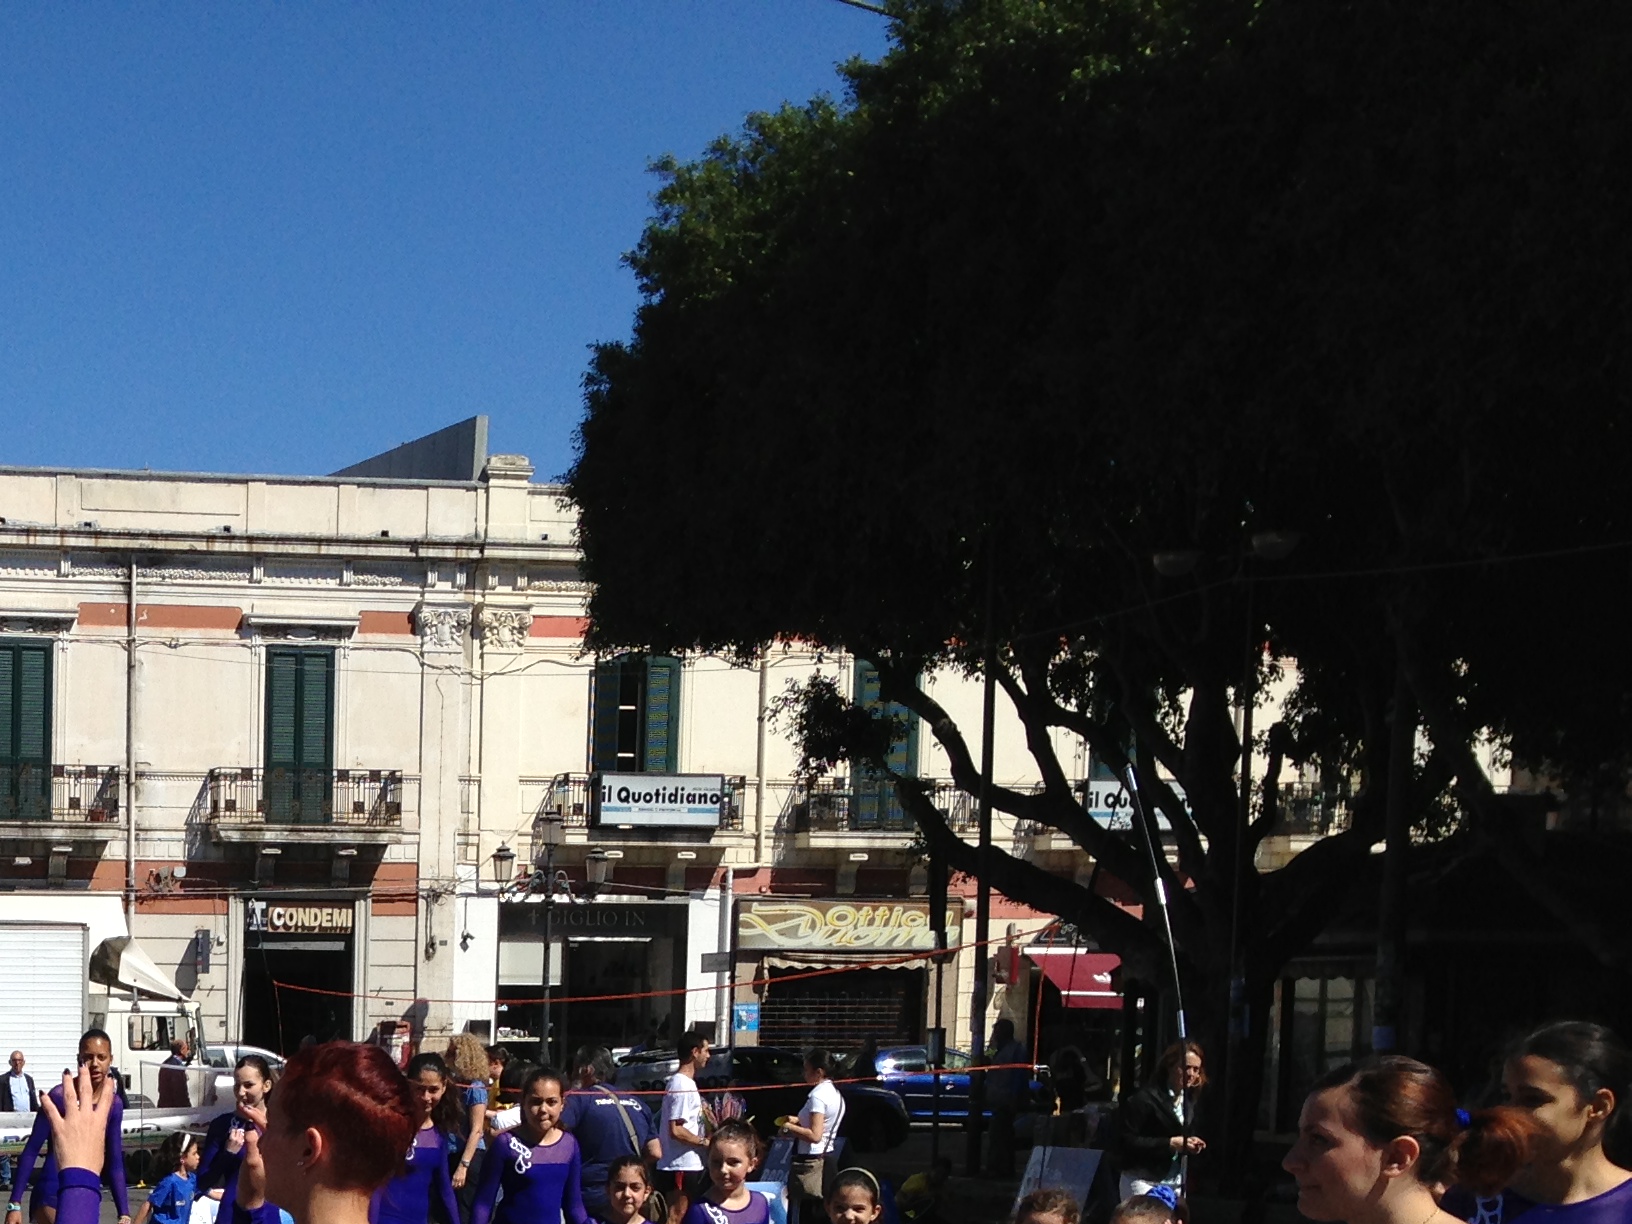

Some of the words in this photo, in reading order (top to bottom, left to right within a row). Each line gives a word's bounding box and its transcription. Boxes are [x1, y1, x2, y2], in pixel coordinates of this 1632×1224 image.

[601, 785, 613, 803] il
[617, 786, 721, 805] Quotidiano
[1088, 792, 1100, 809] il
[272, 907, 353, 927] CONDEMI
[625, 911, 646, 926] IN
